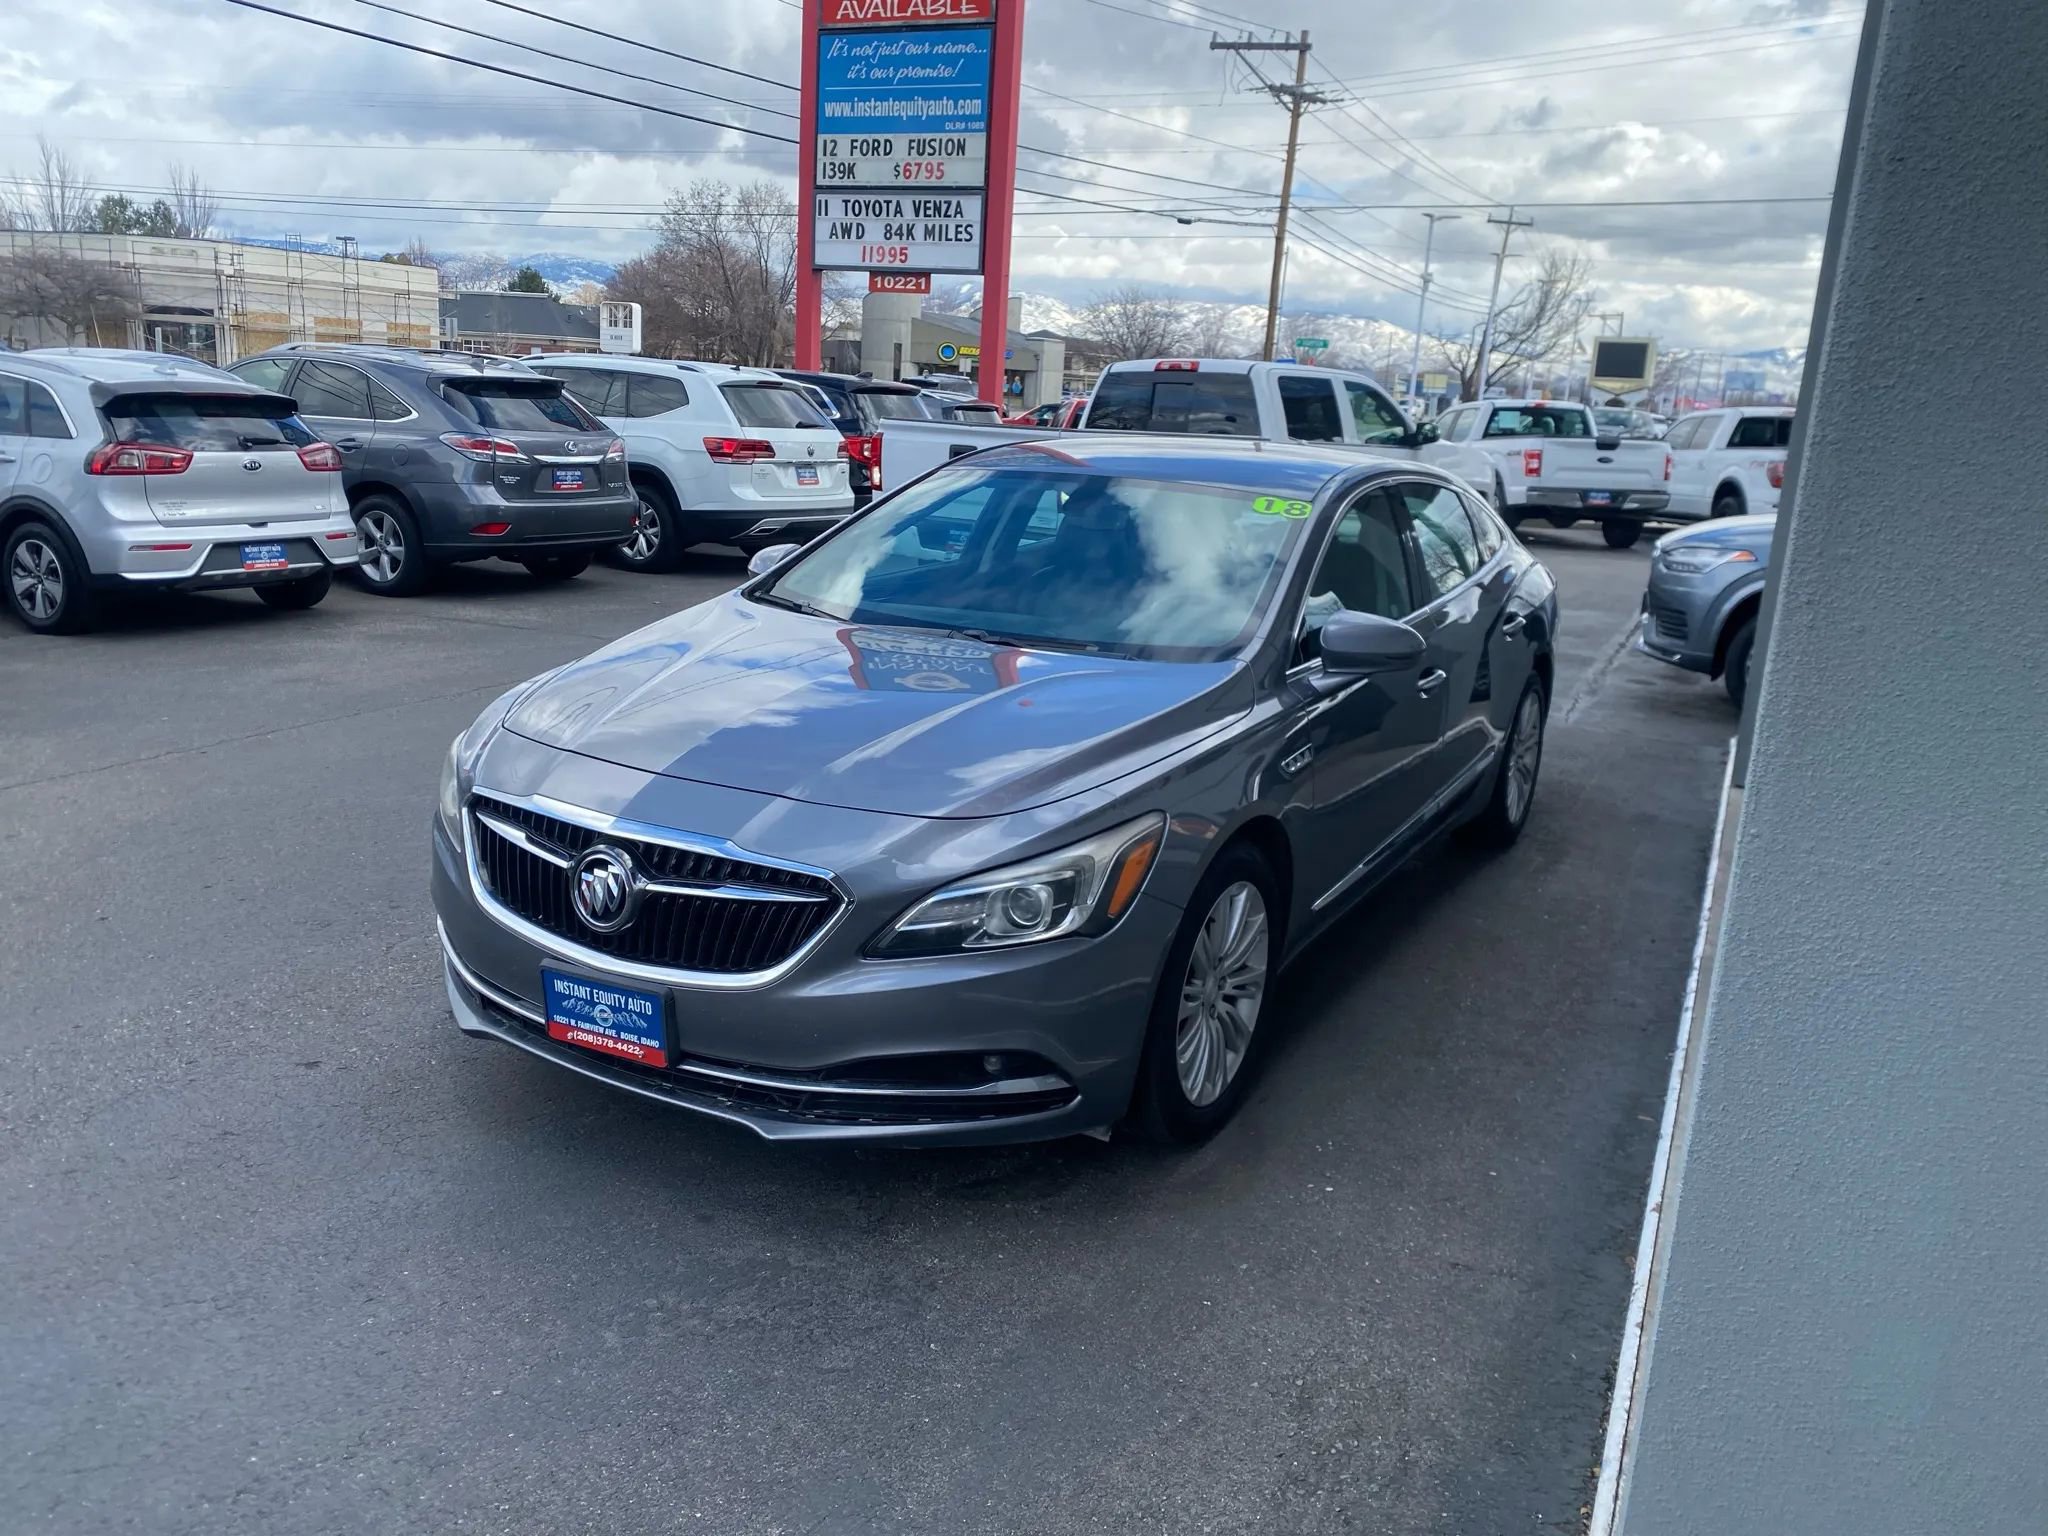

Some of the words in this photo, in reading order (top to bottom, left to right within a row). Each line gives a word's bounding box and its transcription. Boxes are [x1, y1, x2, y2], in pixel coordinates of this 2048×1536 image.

[836, 0, 980, 19] AVAILABLE
[827, 38, 848, 59] It's
[851, 40, 878, 57] not
[870, 39, 906, 64] just
[906, 43, 931, 56] our
[847, 62, 867, 79] it's
[870, 67, 896, 80] our
[893, 59, 964, 85] promise!
[824, 96, 982, 120] www.instantequityauto.com
[822, 139, 838, 157] 12
[850, 138, 893, 157] FORD
[907, 138, 966, 157] FUSION
[822, 162, 857, 180] 139K
[893, 162, 945, 180] $6795
[842, 199, 904, 218] TOYOTA
[912, 200, 964, 219] VENZA
[829, 222, 865, 240] AWD
[883, 223, 916, 241] 84K
[924, 224, 974, 242] MILES
[861, 245, 909, 264] 11995
[873, 276, 927, 290] 10221
[1260, 498, 1311, 517] 18
[553, 979, 591, 1000] INSTANT
[593, 988, 626, 1009] EQUITY
[628, 997, 653, 1015] AUTO
[573, 1030, 640, 1055] (208)378-4422
[578, 1021, 604, 1034] FAIRVIEW
[641, 1036, 660, 1048] IDAHO
